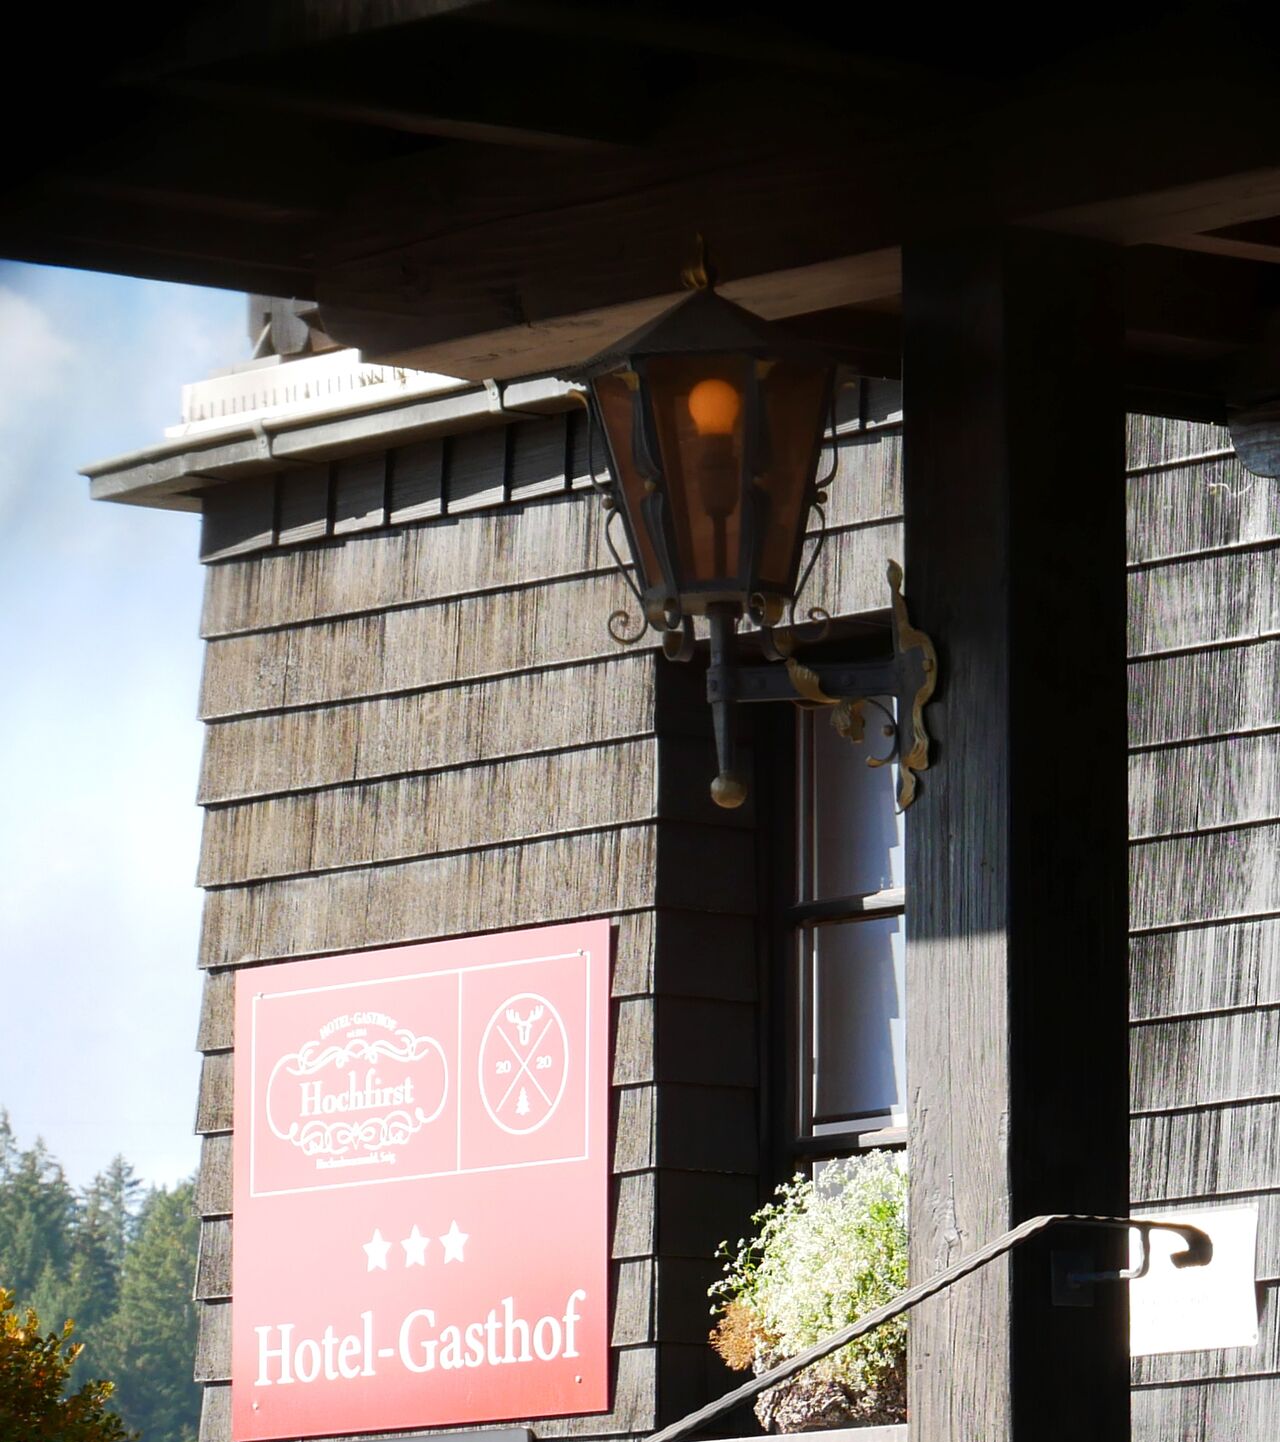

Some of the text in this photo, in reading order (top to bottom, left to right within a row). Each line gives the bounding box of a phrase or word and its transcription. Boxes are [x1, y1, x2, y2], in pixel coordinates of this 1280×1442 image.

[495, 1055, 553, 1074] 20 20
[299, 1067, 415, 1118] Hochfirst
[253, 1288, 587, 1387] Hotel-Gasthof
